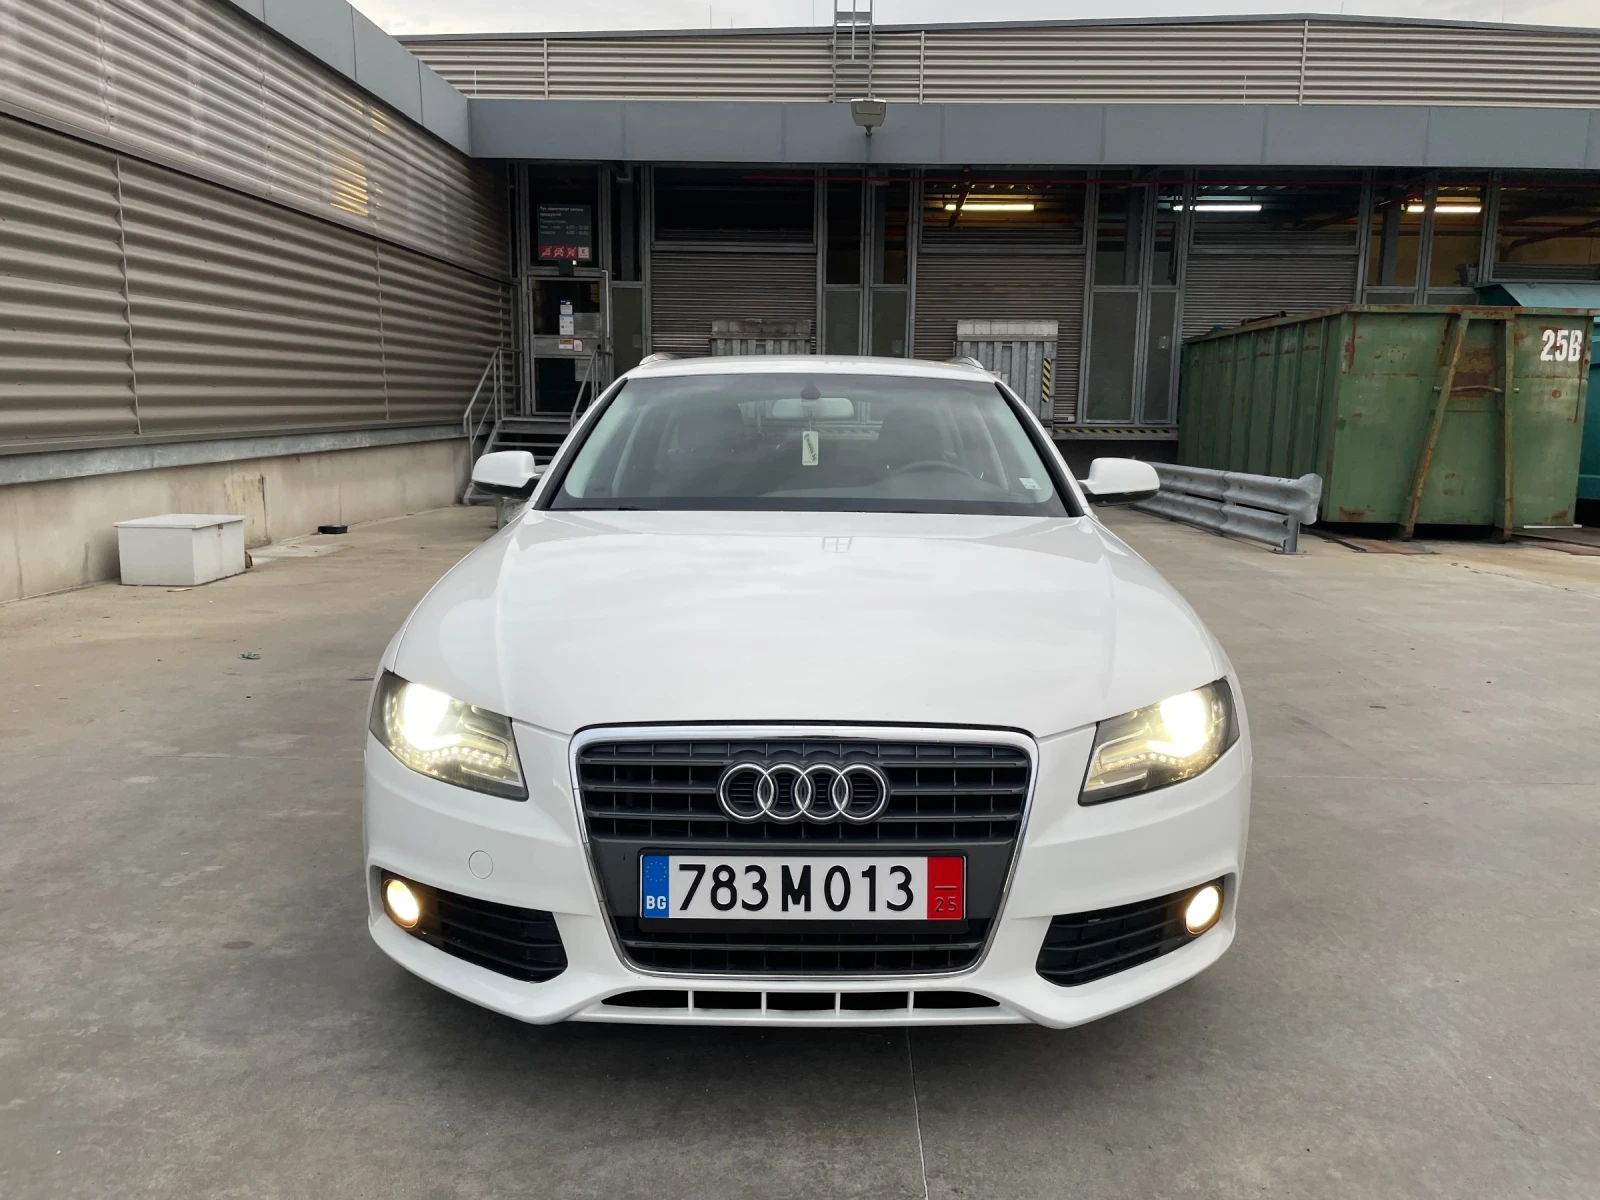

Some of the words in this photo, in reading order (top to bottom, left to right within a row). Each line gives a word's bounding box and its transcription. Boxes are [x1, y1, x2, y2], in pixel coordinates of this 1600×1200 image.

[1540, 329, 1583, 362] 25B
[646, 895, 667, 910] BG
[934, 896, 957, 913] 25
